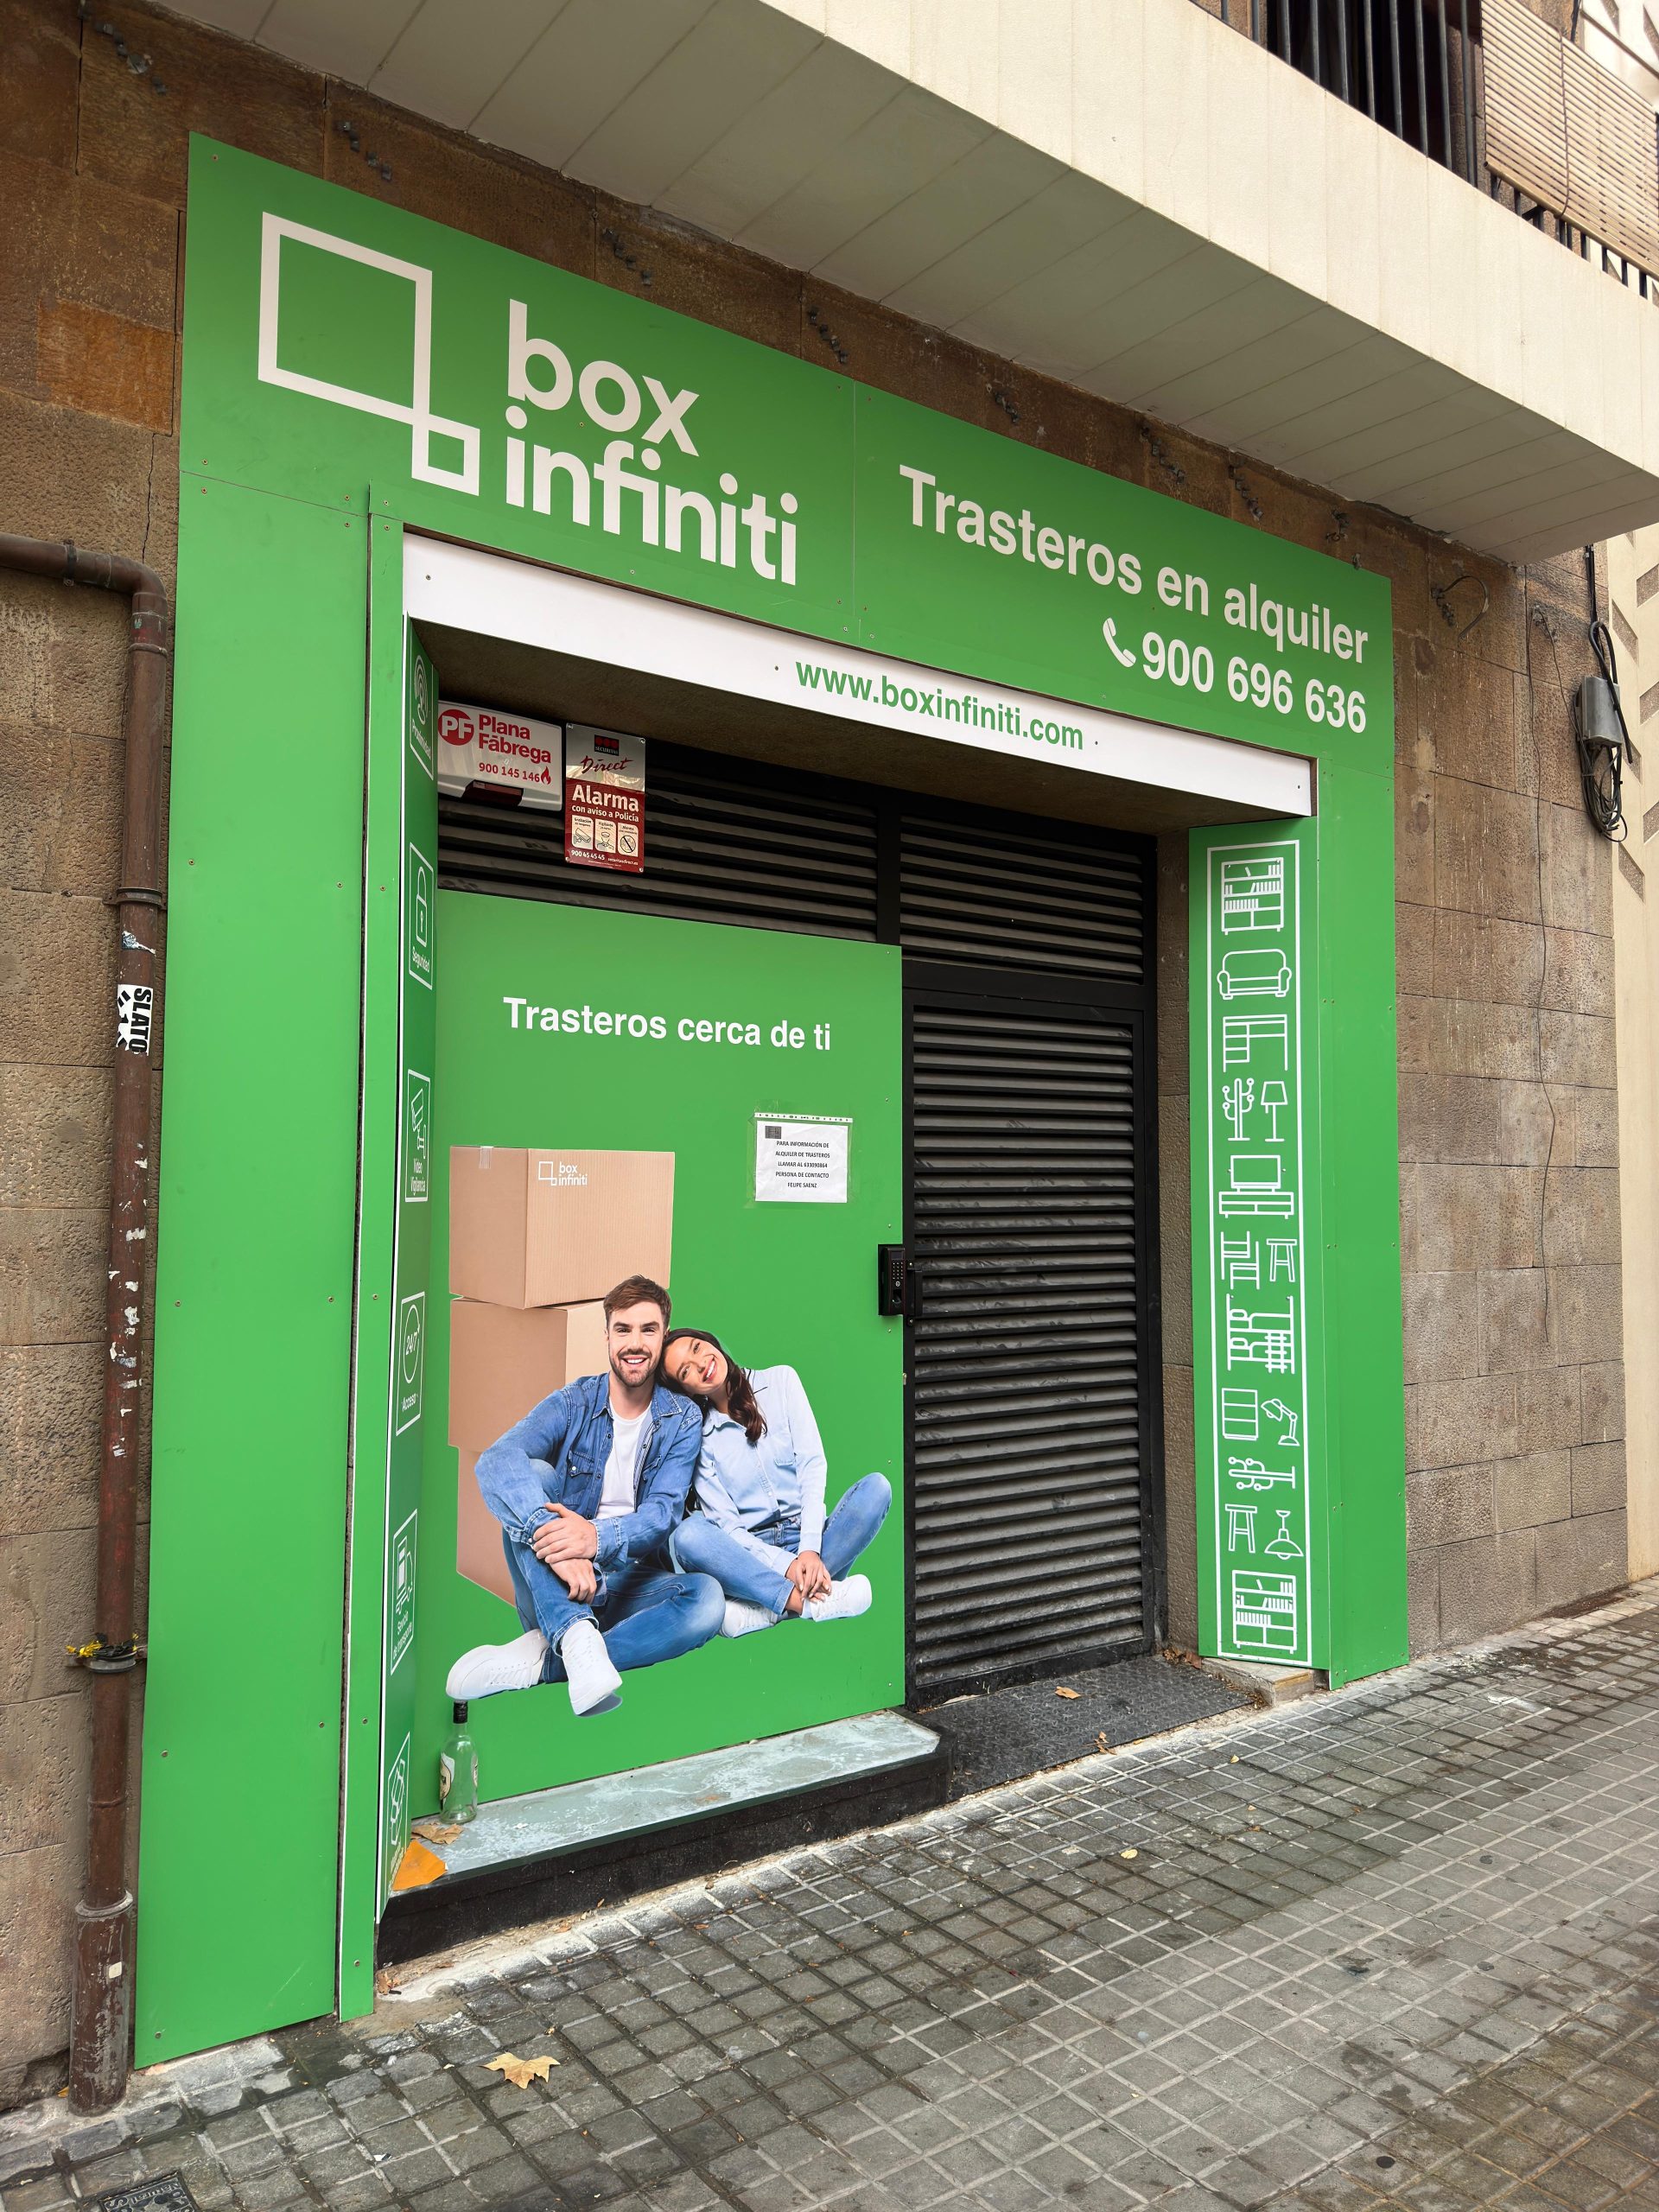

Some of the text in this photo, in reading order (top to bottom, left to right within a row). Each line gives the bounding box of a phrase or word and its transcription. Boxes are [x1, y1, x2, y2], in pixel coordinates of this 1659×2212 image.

[508, 299, 700, 457] box
[505, 405, 798, 586] infiniti
[899, 464, 1368, 664] Trasteros en alquiler
[1142, 632, 1367, 734] 900 696 636
[796, 662, 1084, 750] www.boxinfiniti.com
[442, 715, 472, 739] PF
[479, 715, 531, 740] Plana
[479, 762, 540, 783] 900 145 146
[581, 755, 633, 774] Direct
[572, 785, 639, 812] Alarma
[572, 804, 586, 813] con
[588, 807, 607, 817] aviso
[614, 810, 639, 823] Policía
[503, 996, 830, 1051] Trasteros cerca de ti
[558, 1174, 588, 1186] infiniti
[560, 1161, 578, 1173] box
